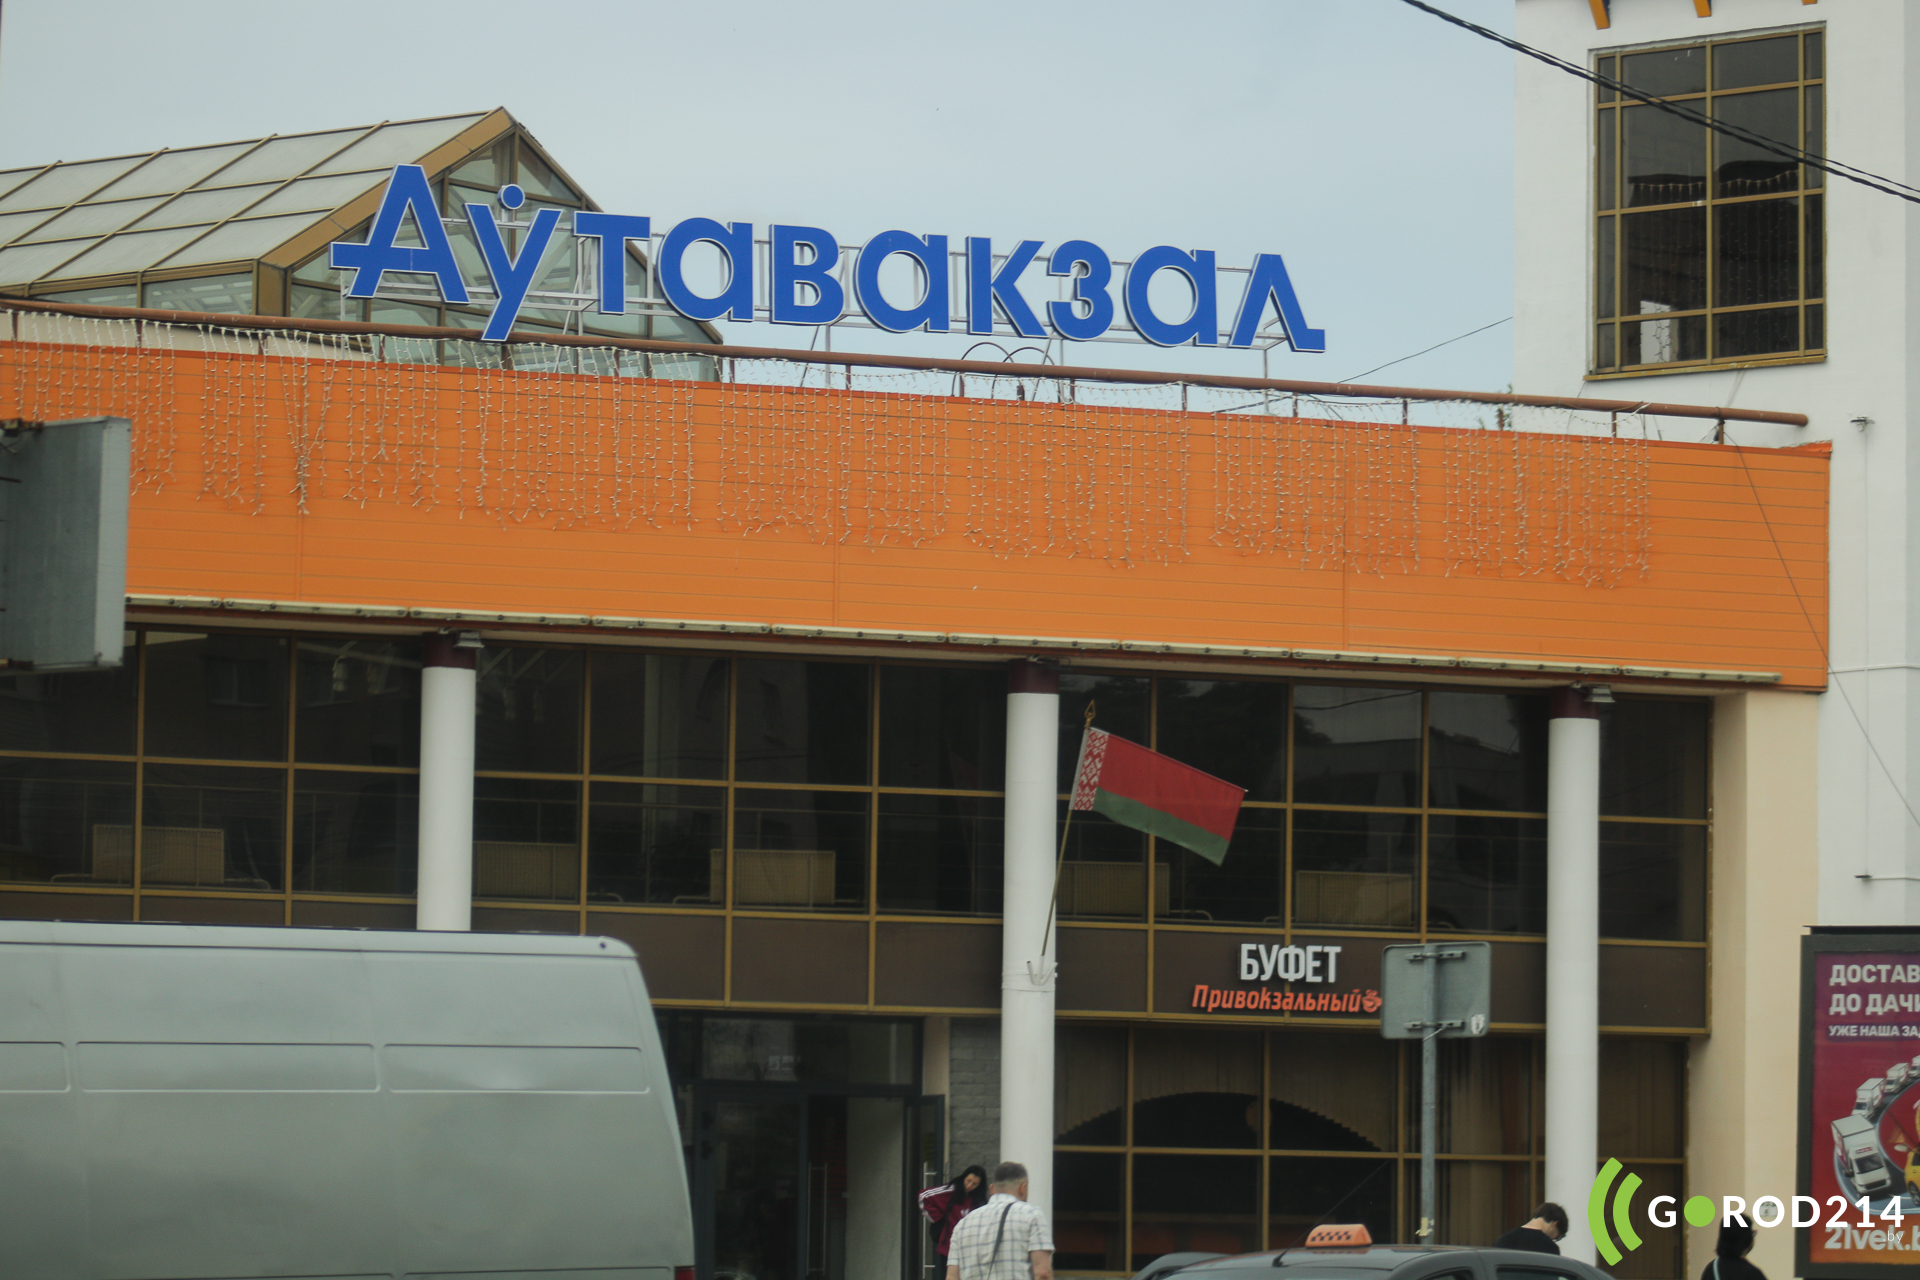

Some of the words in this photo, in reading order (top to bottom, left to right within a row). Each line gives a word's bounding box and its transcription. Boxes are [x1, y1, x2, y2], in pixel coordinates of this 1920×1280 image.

[1240, 943, 1342, 983] БУФЕТ
[1192, 985, 1362, 1012] Привокзальный
[1829, 993, 1861, 1015] ДО
[1828, 1025, 1858, 1036] УЖЕ
[1860, 1025, 1900, 1036] НАША
[1901, 1025, 1920, 1038] ЗА
